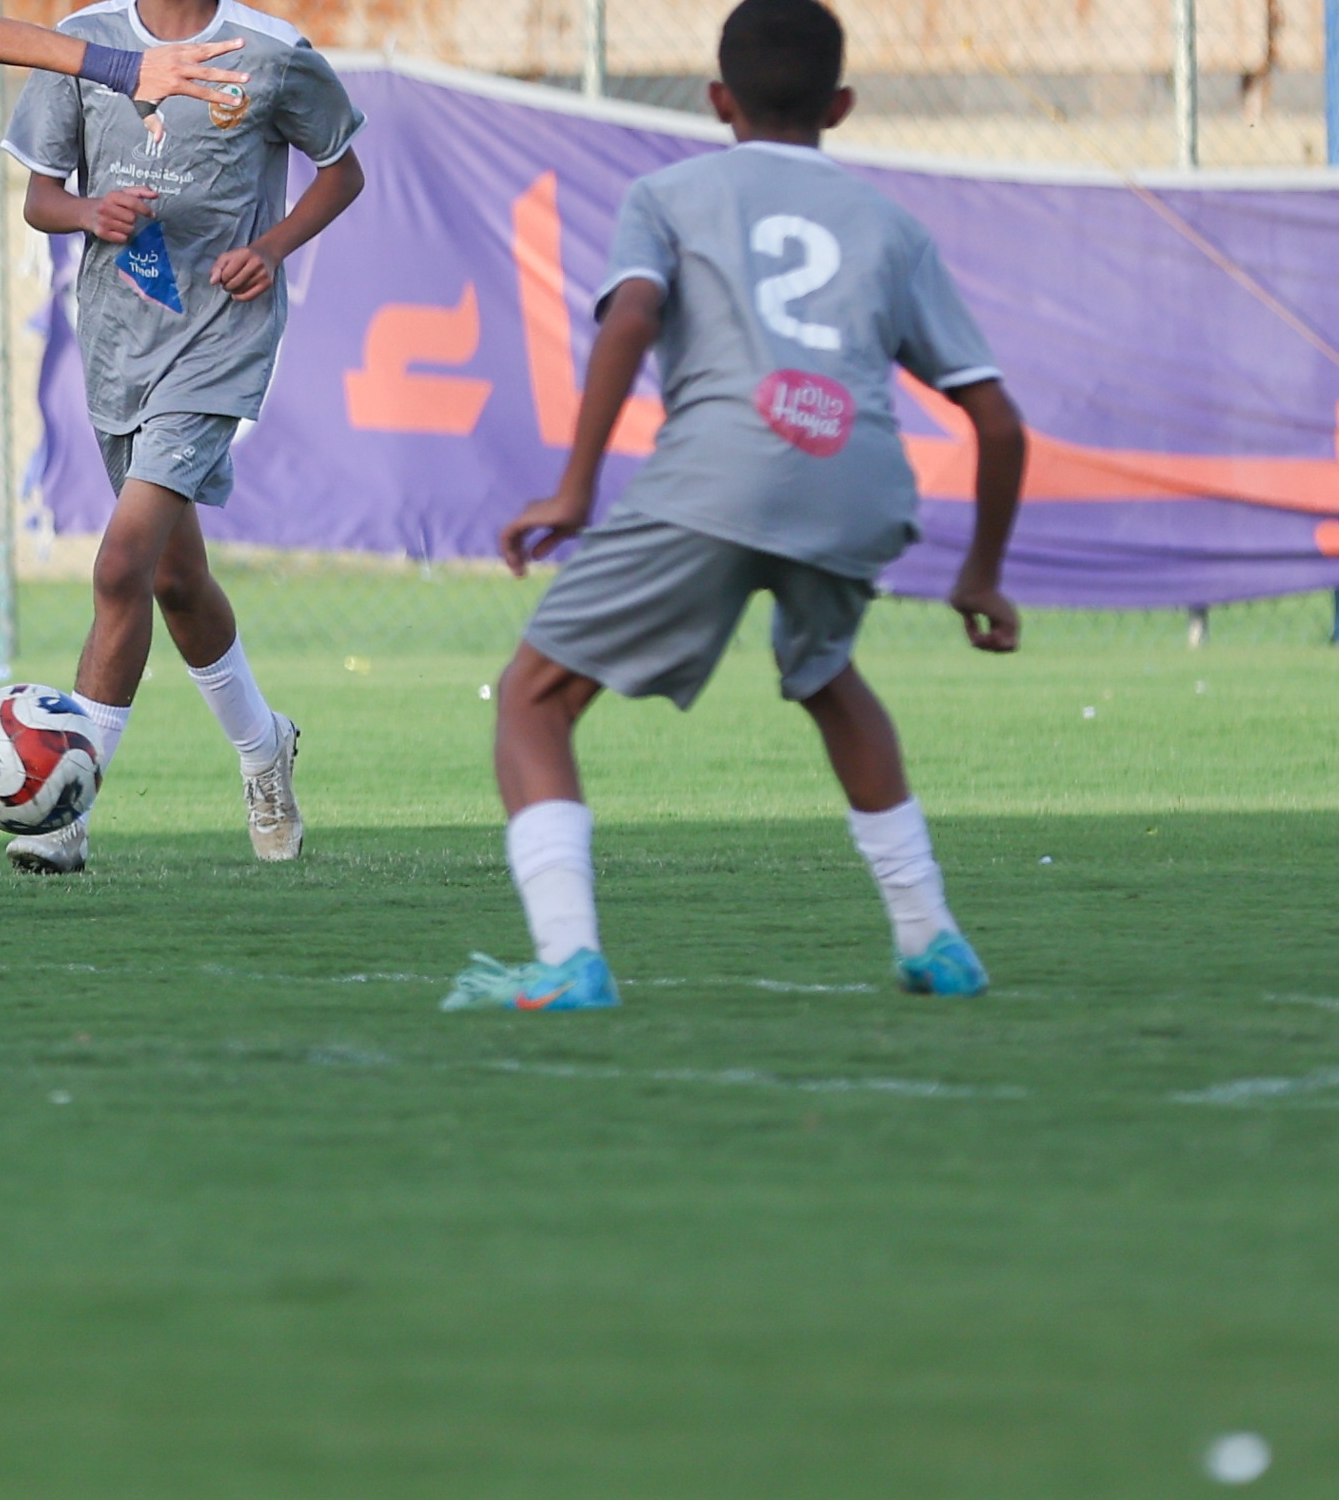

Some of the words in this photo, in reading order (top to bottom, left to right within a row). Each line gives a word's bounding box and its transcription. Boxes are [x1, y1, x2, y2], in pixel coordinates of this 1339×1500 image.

[128, 249, 160, 267] ذيب
[128, 261, 160, 279] Theeb
[751, 215, 840, 350] 2
